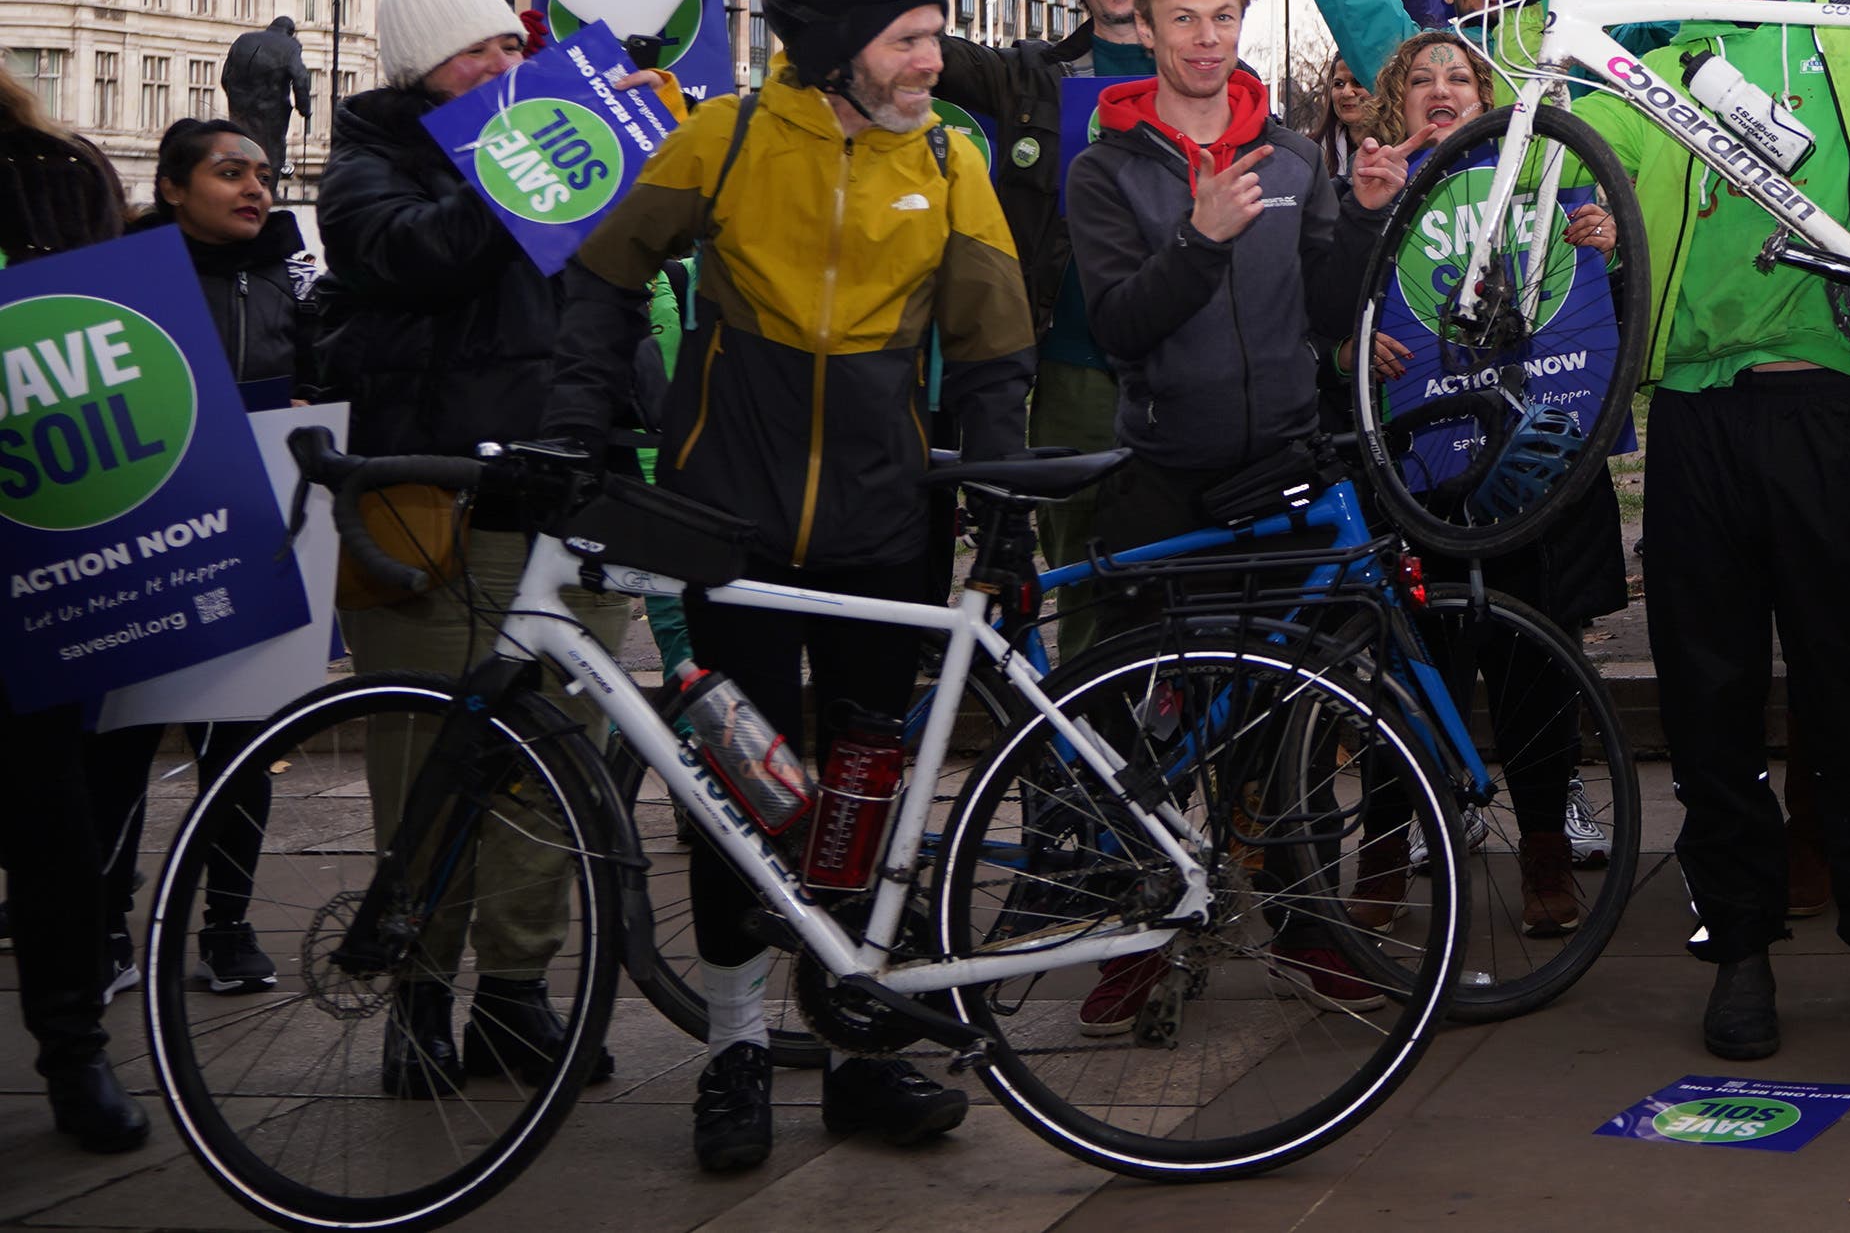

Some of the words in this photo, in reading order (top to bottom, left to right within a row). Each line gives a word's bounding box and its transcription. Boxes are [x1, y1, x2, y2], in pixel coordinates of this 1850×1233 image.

[566, 45, 598, 78] ONE
[588, 79, 632, 124] REACH
[625, 88, 670, 139] avesoil.org
[531, 108, 609, 191] SOIL
[624, 121, 658, 153] ONE
[1618, 62, 1816, 222] boardman
[485, 129, 571, 213] SAVE
[1421, 193, 1538, 260] SAE
[0, 319, 141, 418] AVE
[1424, 366, 1503, 398] ACTIO
[1523, 350, 1587, 379] NOW
[1542, 389, 1591, 405] Happen
[0, 393, 166, 500] SOIL
[11, 543, 130, 598] ACTION
[137, 508, 228, 558] NOW
[24, 612, 54, 632] Let
[58, 604, 83, 623] Us
[88, 590, 139, 611] Make
[145, 578, 164, 594] It
[169, 557, 242, 589] Happen
[59, 612, 188, 661] savesoil.org
[1678, 1083, 1713, 1092] ONE
[1695, 1101, 1785, 1122] SOIL
[1715, 1087, 1770, 1095] REACH
[1664, 1115, 1767, 1137] SAVE
